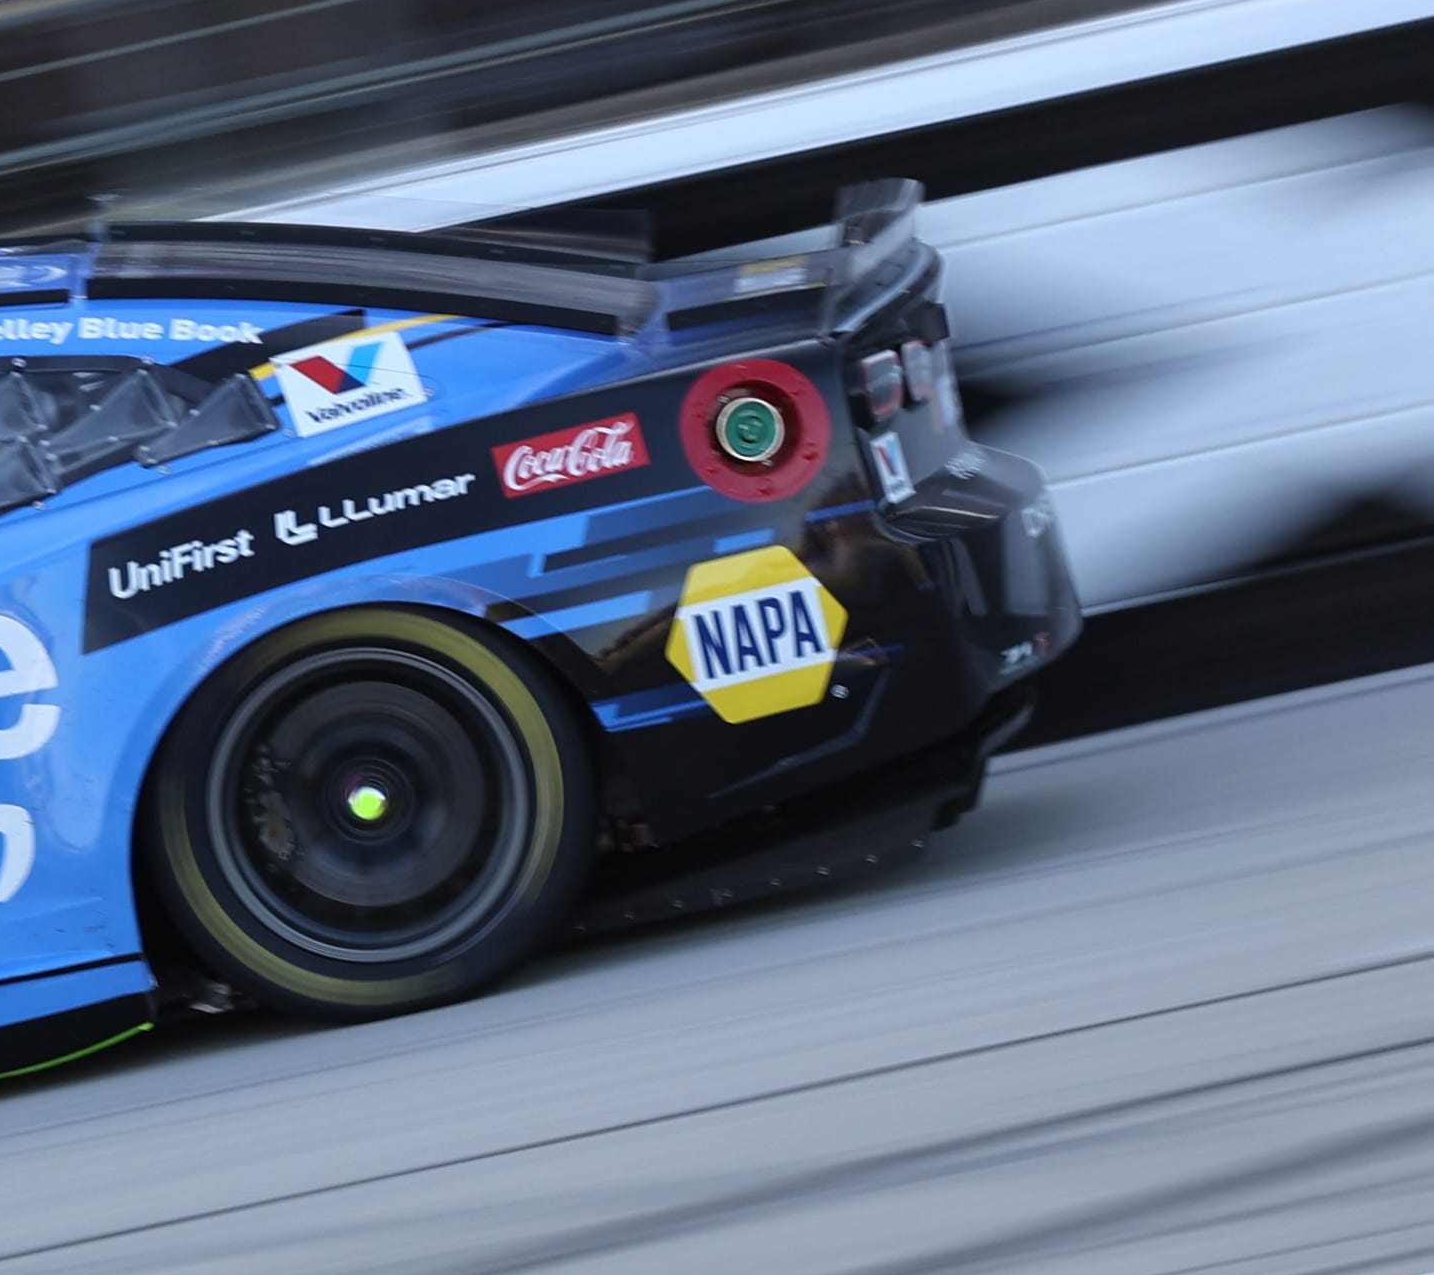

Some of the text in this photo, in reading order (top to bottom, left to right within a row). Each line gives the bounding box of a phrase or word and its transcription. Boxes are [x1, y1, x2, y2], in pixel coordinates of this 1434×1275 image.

[78, 316, 165, 341] Blue
[169, 318, 264, 344] Book
[108, 529, 256, 599] UniFirst
[693, 590, 826, 679] NAPA
